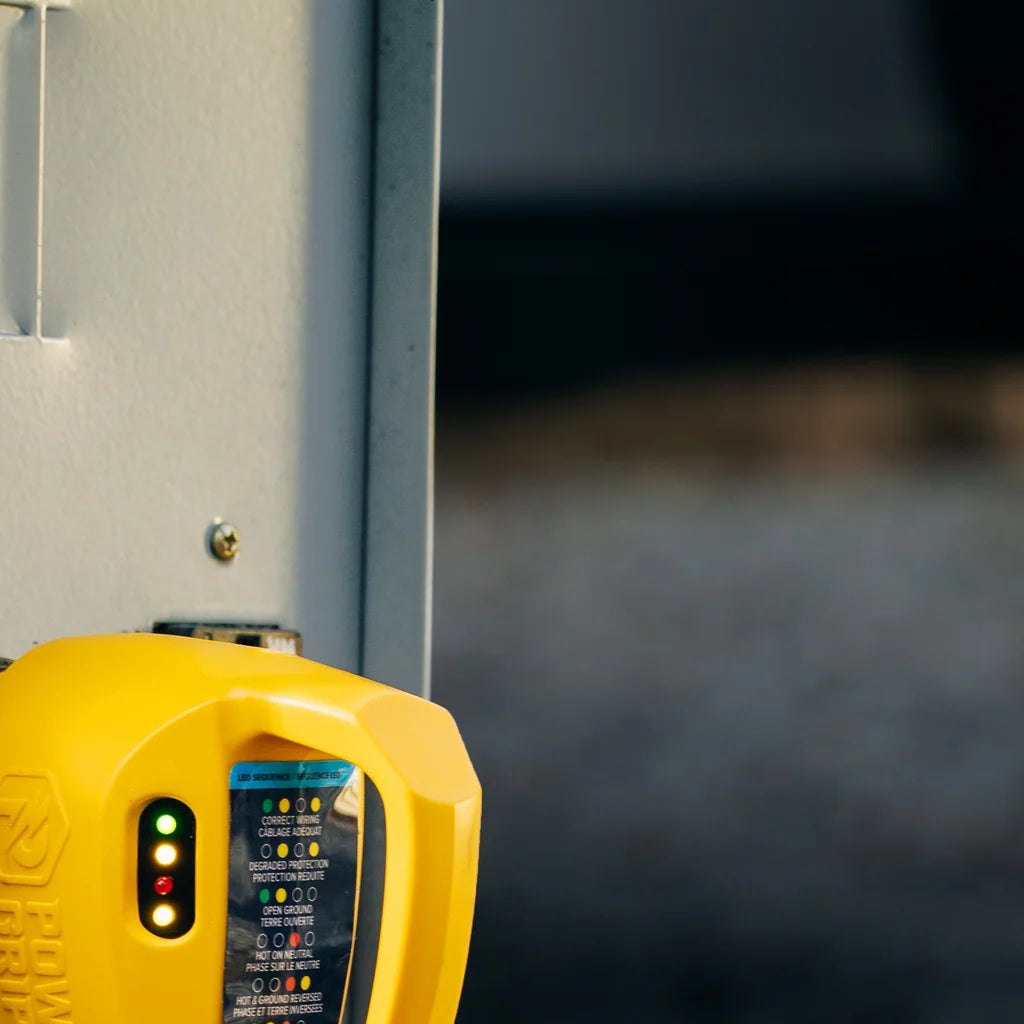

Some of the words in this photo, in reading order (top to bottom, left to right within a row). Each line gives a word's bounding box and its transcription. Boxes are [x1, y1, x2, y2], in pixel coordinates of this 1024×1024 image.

[237, 773, 251, 781] LED
[261, 815, 295, 825] CORRECT
[296, 814, 320, 824] WIRING
[248, 860, 287, 871] DEGRADED
[288, 859, 329, 869] PROTECTION
[252, 872, 296, 883] PROTECTION
[262, 905, 282, 915] OPEN
[283, 904, 313, 915] GROUND
[260, 917, 283, 927] TERRE
[283, 915, 315, 926] OUVERTE
[255, 950, 271, 960] HOT
[271, 950, 283, 960] ON
[283, 949, 313, 959] NEUTRAL
[245, 962, 269, 972] PHASE
[270, 962, 285, 972] SUR
[286, 961, 295, 971] LE
[295, 960, 320, 970] NEUTRE
[236, 996, 252, 1005] HOT
[252, 996, 258, 1005] &
[258, 994, 289, 1005] GROUND
[290, 992, 323, 1003] REVERSED
[233, 1007, 256, 1017] PHASE
[257, 1007, 266, 1016] ET
[266, 1006, 288, 1016] TERRE
